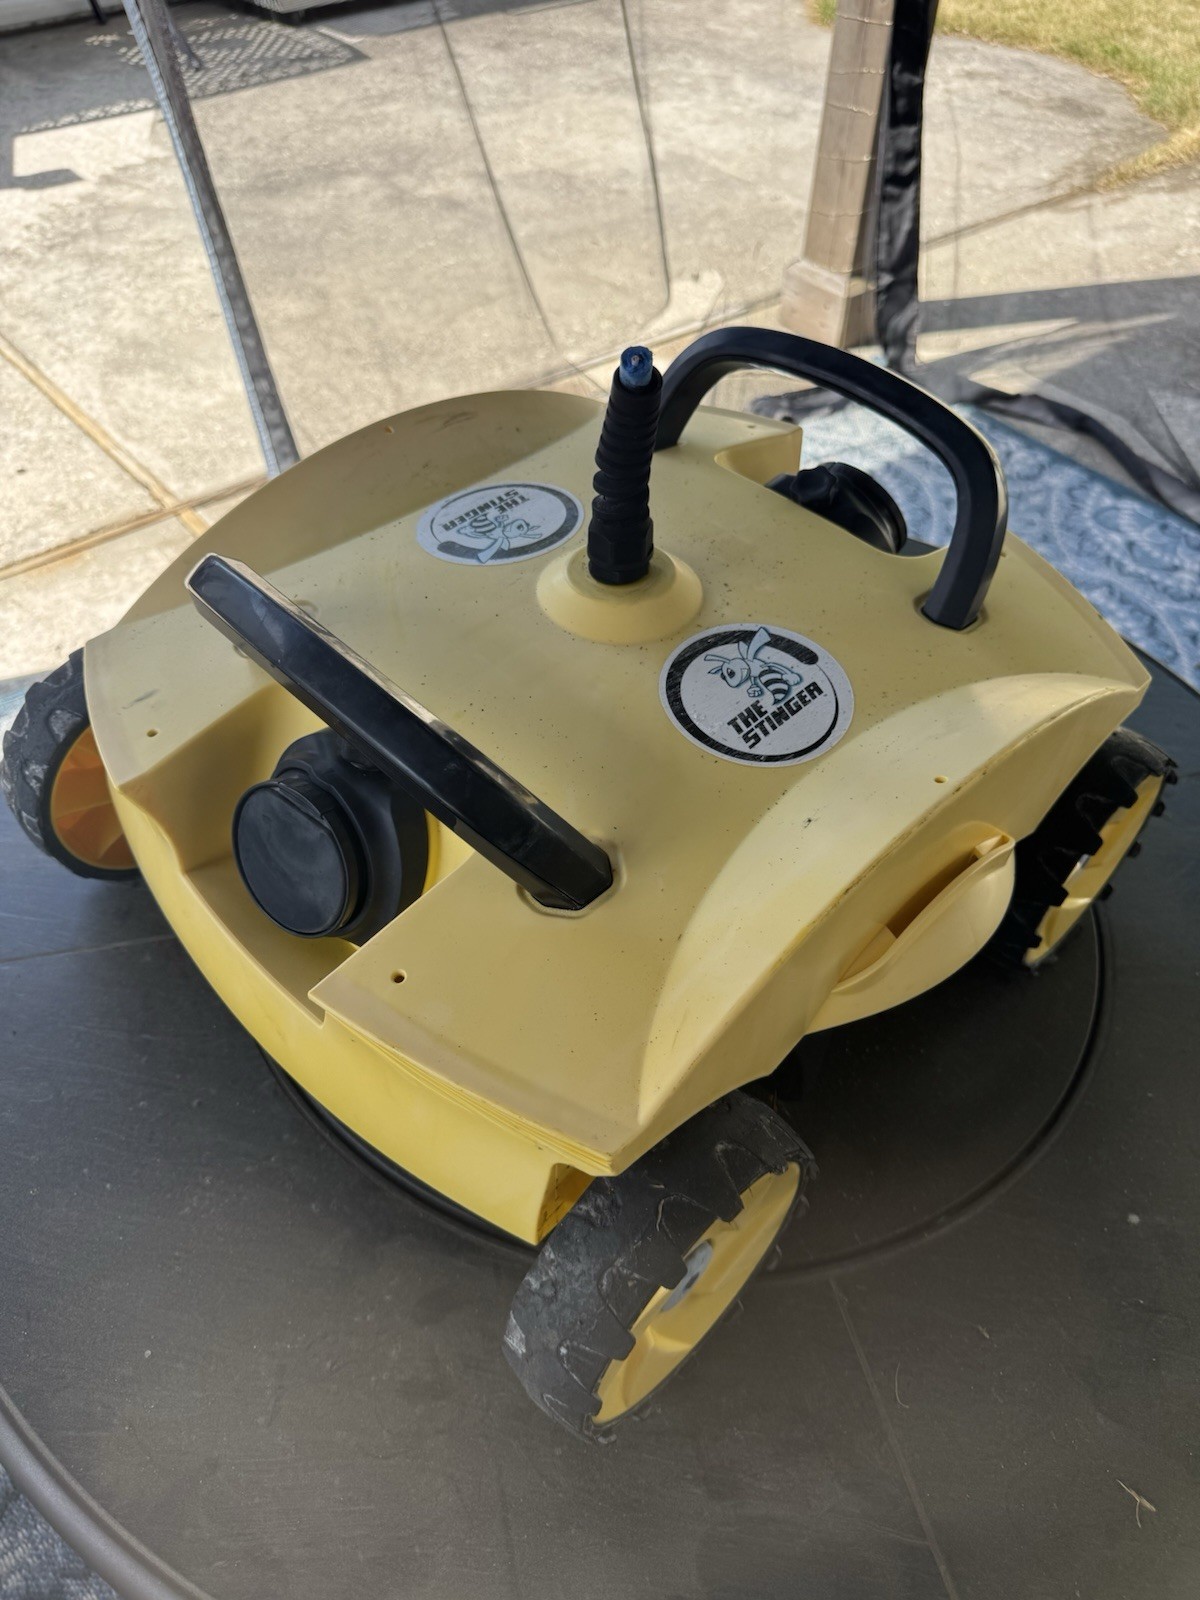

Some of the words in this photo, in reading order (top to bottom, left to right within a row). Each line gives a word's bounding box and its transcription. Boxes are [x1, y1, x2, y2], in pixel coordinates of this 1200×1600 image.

[442, 489, 519, 531] STINGER
[497, 495, 530, 514] THE
[727, 700, 768, 735] THE
[742, 681, 823, 749] STINGER
